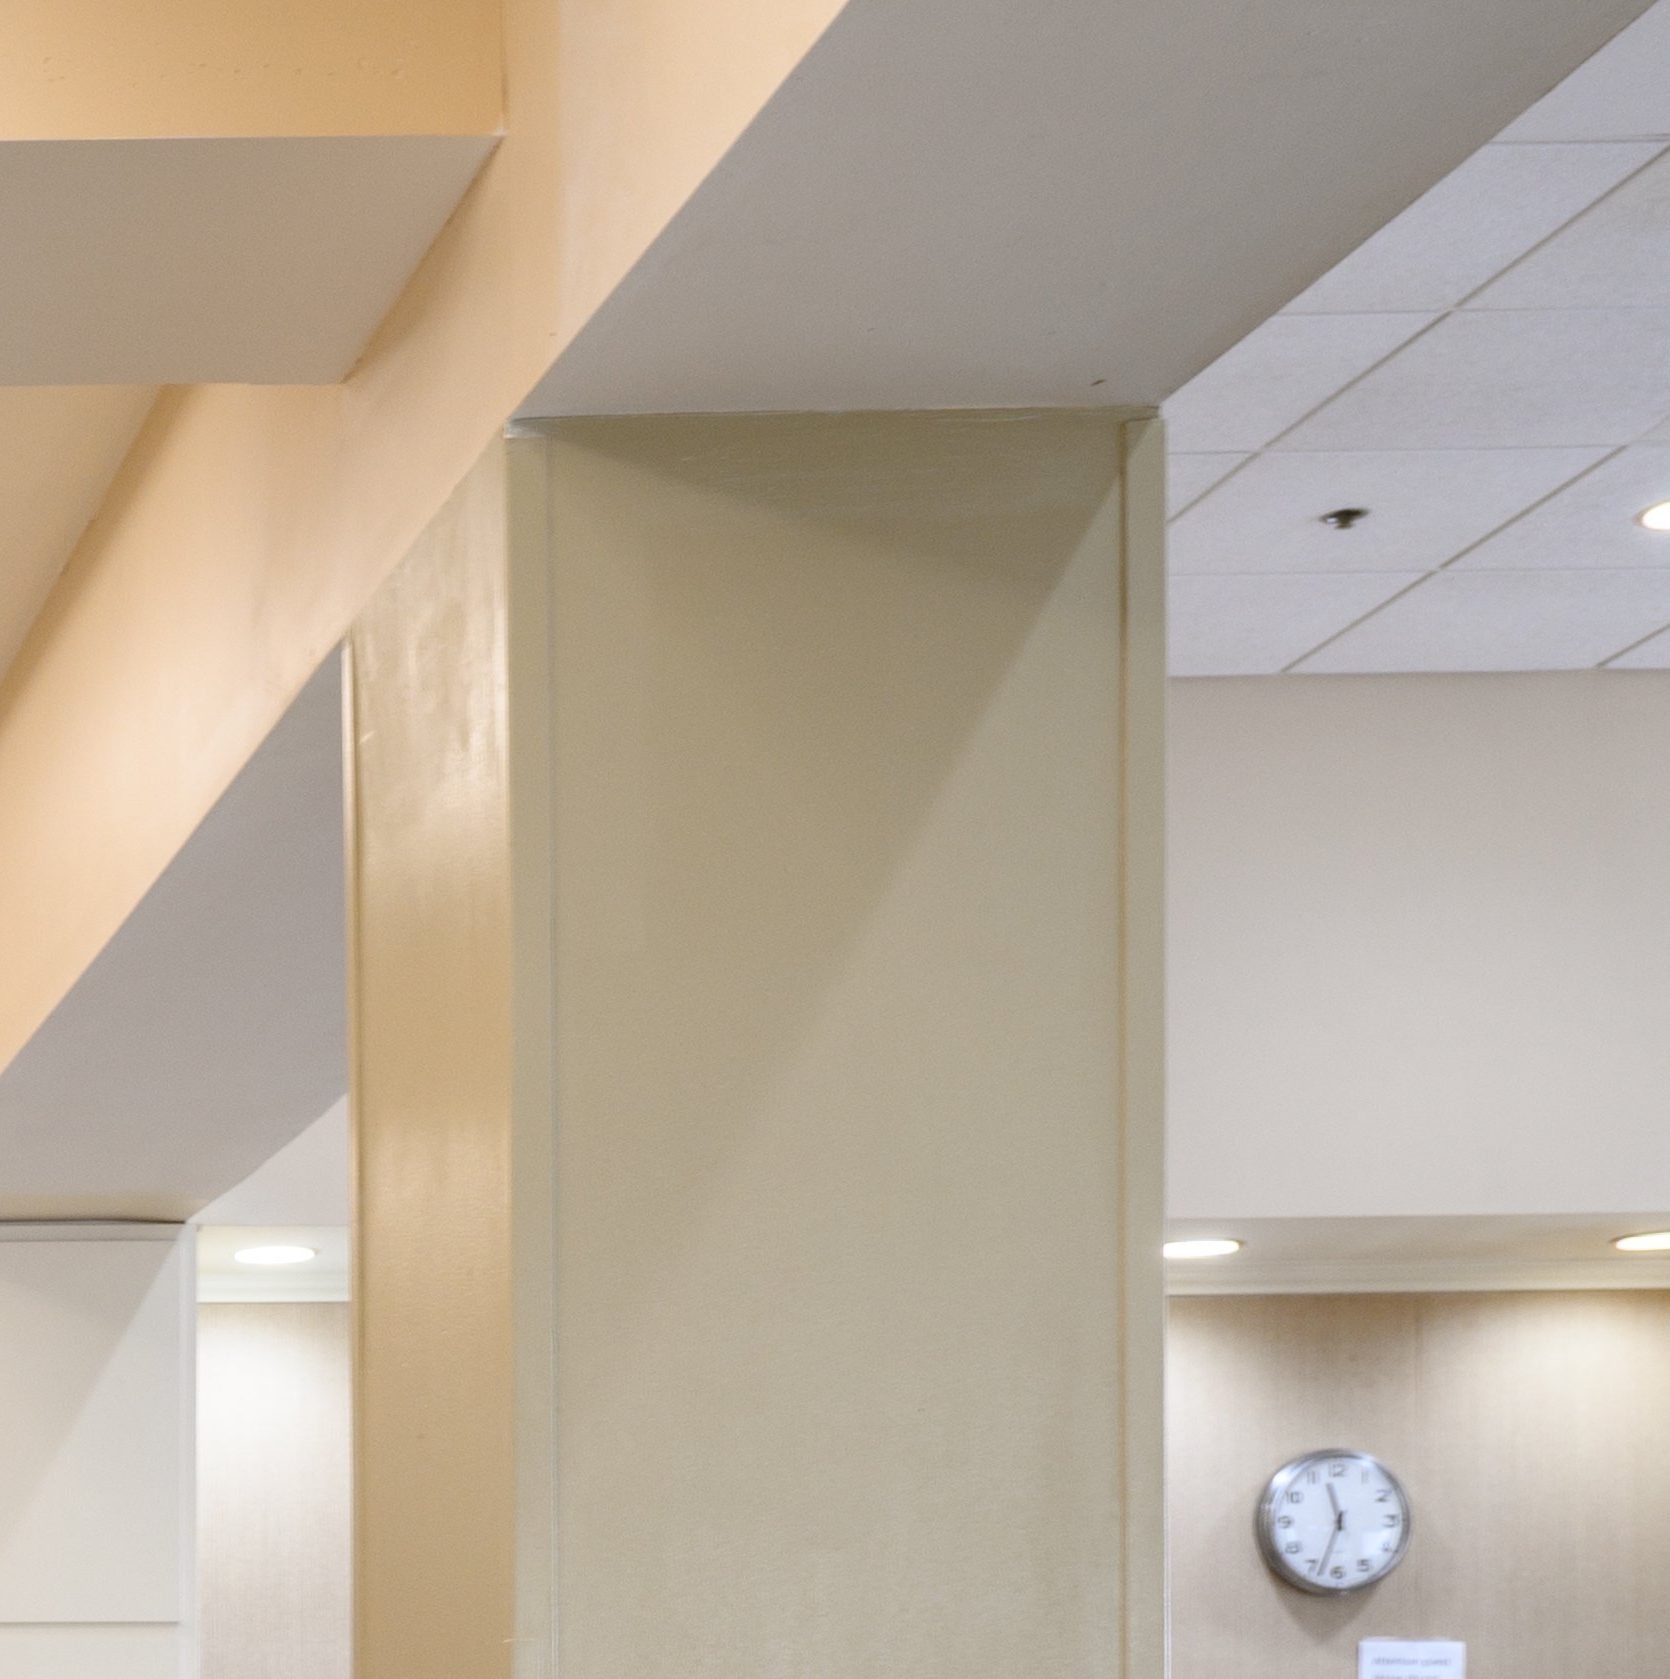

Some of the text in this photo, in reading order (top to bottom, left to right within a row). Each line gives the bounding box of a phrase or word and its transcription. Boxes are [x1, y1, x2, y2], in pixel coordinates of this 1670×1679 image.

[1328, 1463, 1347, 1478] 12
[1287, 1491, 1304, 1504] 10
[1375, 1489, 1391, 1502] 2
[1277, 1515, 1293, 1529] 9
[1382, 1514, 1398, 1528] 3
[1284, 1541, 1301, 1555] 8
[1330, 1565, 1347, 1580] 6
[1356, 1558, 1372, 1573] 5
